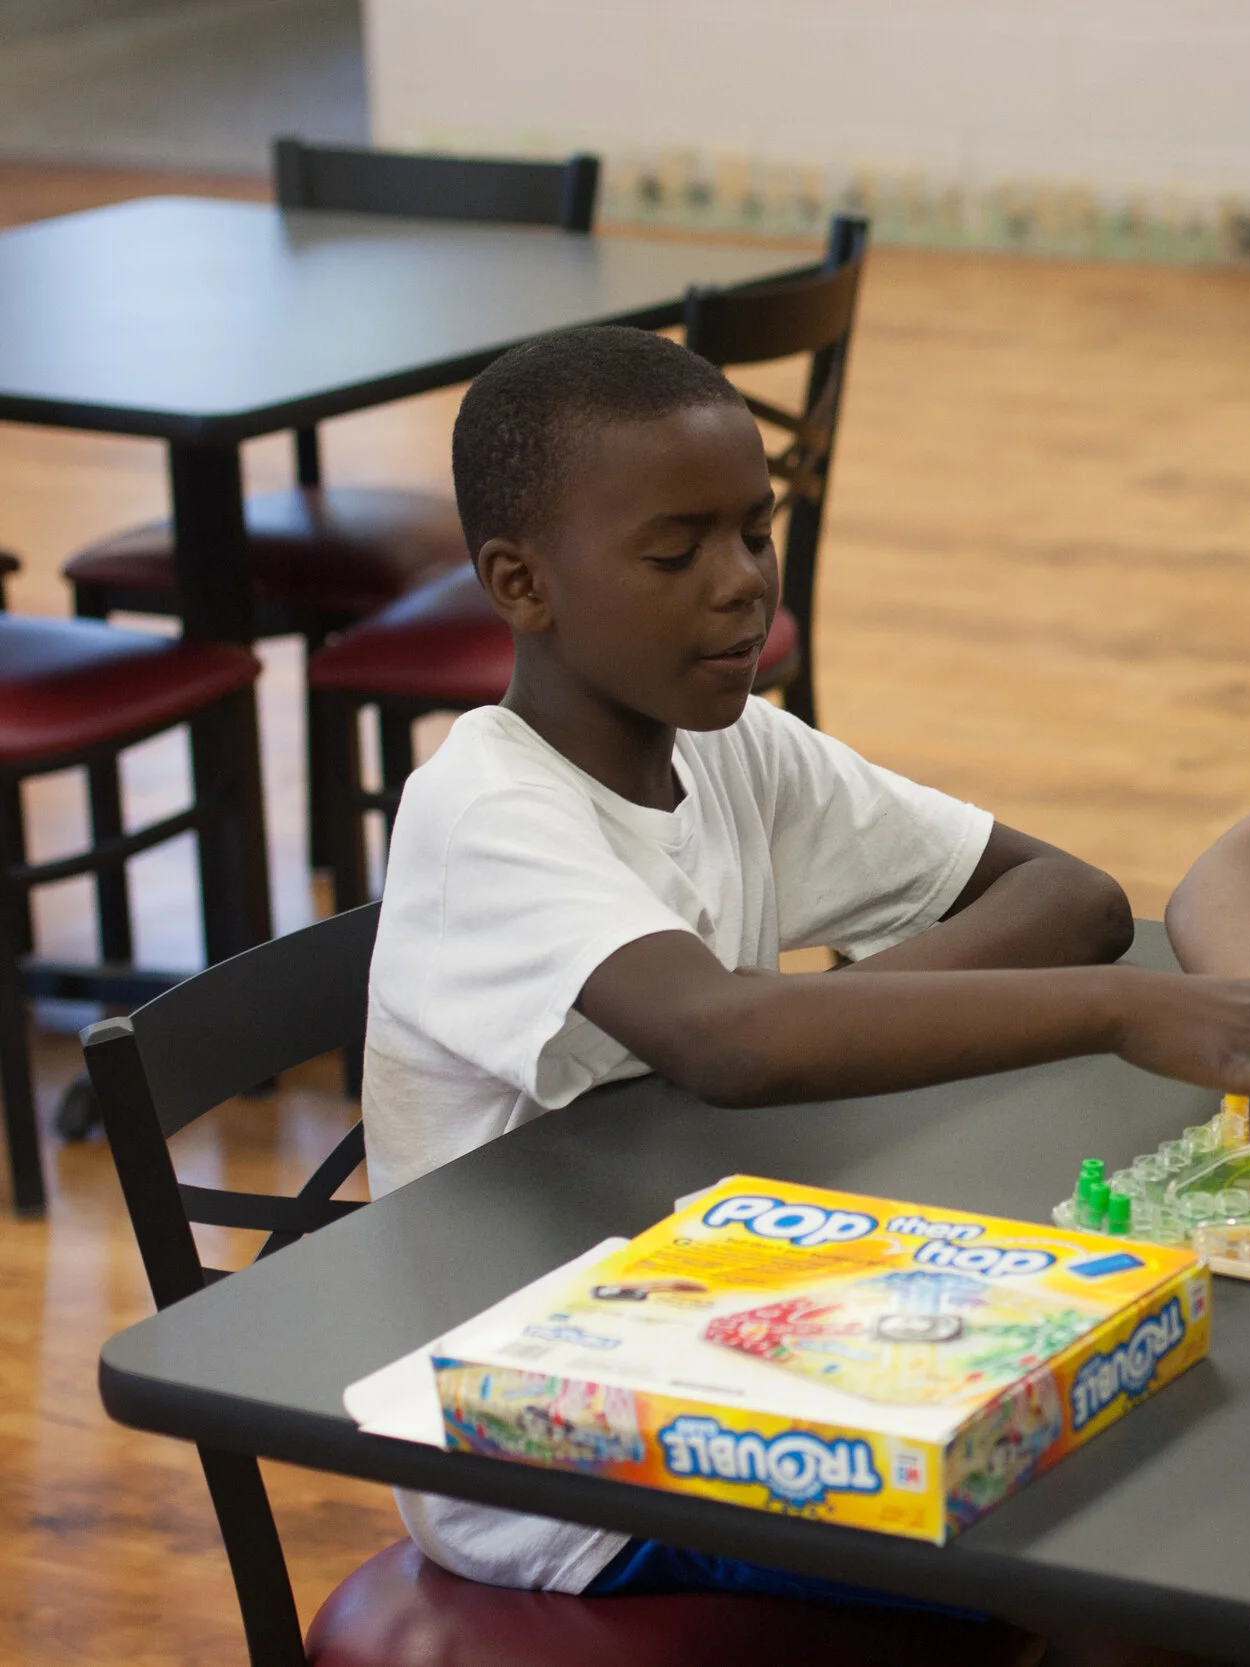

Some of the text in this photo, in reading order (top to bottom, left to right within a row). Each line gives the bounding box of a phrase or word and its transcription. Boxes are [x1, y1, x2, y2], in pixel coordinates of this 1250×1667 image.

[886, 1215, 985, 1240] then
[1072, 1299, 1184, 1428] TROUBLE
[664, 1429, 880, 1489] TROUBLE
